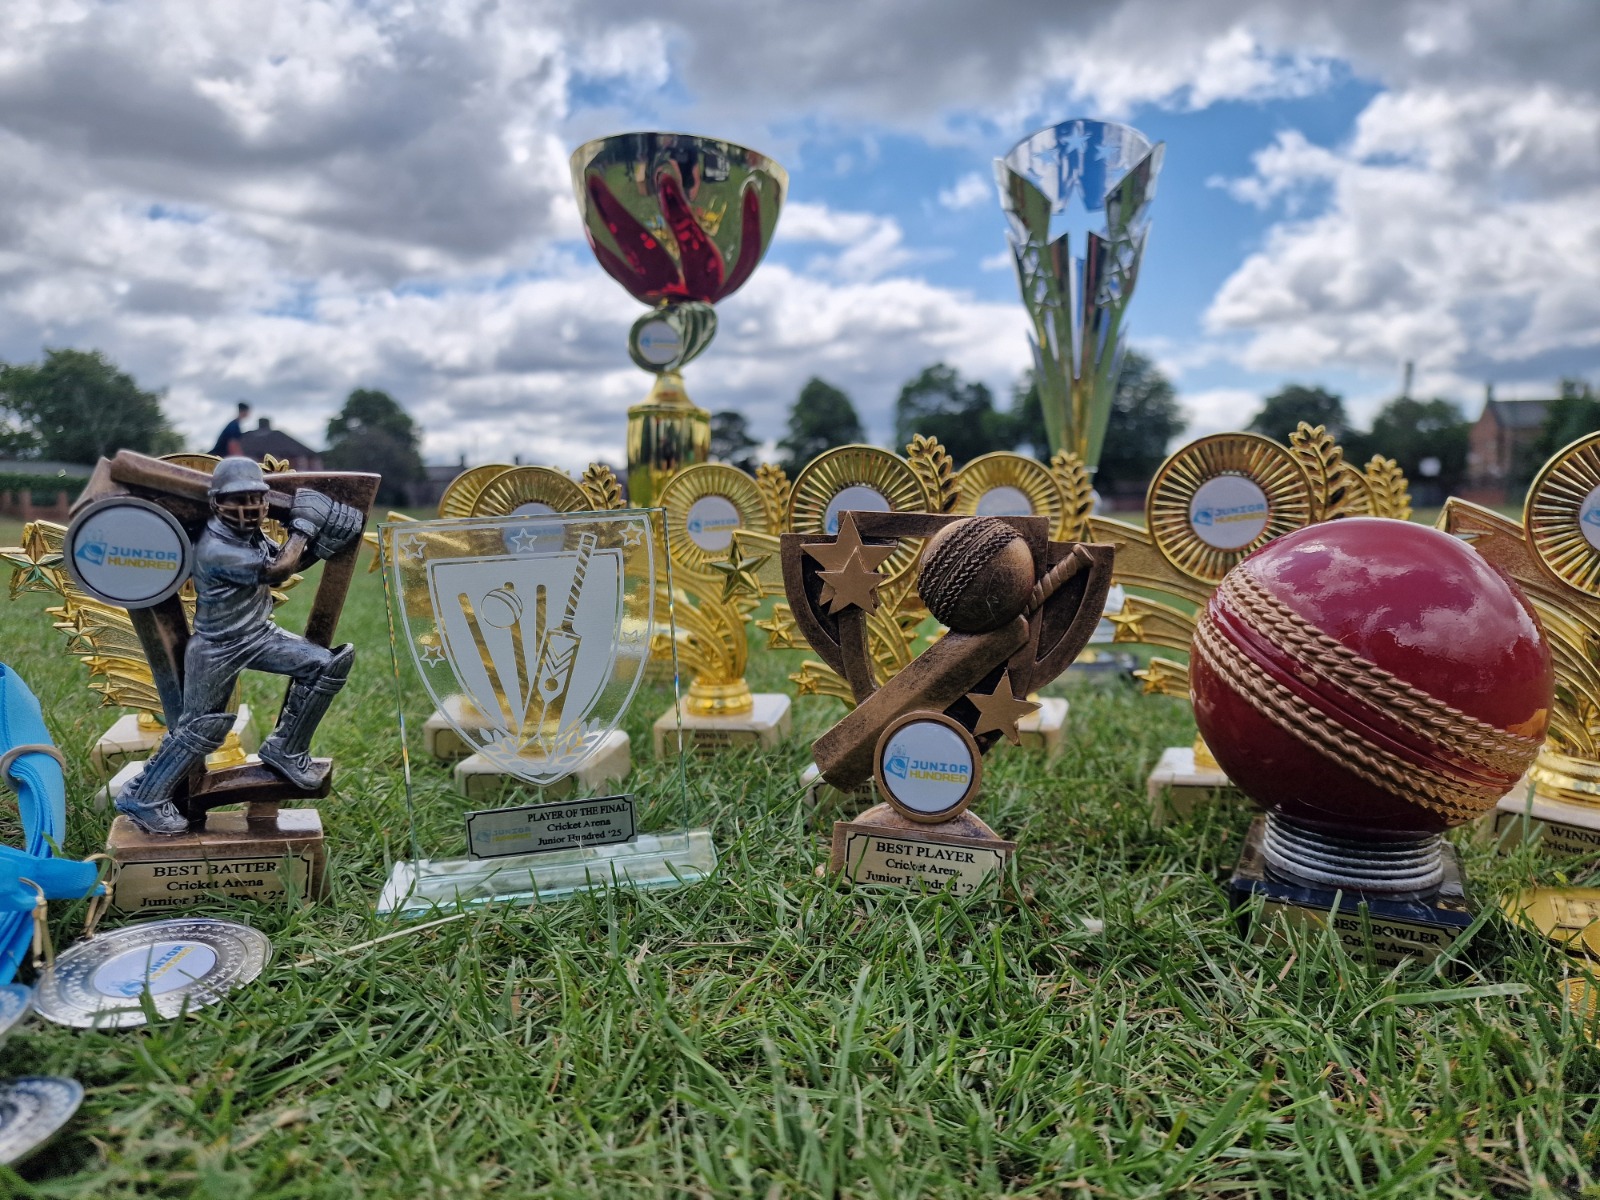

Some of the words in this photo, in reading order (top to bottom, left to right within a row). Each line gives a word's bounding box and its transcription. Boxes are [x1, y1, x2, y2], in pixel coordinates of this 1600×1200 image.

[109, 546, 177, 561] JUNIOR
[107, 557, 177, 571] HUNDRED
[911, 760, 968, 774] JUNIOR
[909, 770, 968, 784] HUNDRED
[527, 810, 565, 823] PLAYER
[566, 809, 578, 819] OF
[580, 806, 599, 816] THE
[600, 803, 628, 814] FINAL
[547, 821, 581, 832] Cricket
[583, 818, 611, 828] Arena
[538, 835, 566, 846] Junior
[567, 831, 605, 843] Hundred
[876, 841, 914, 856] BEST
[916, 845, 976, 863] PLAYER
[153, 865, 202, 877] BEST
[207, 862, 277, 875] BATTER
[865, 870, 902, 884] Junior
[140, 896, 189, 907] Junior
[1371, 924, 1441, 945] BOWLER
